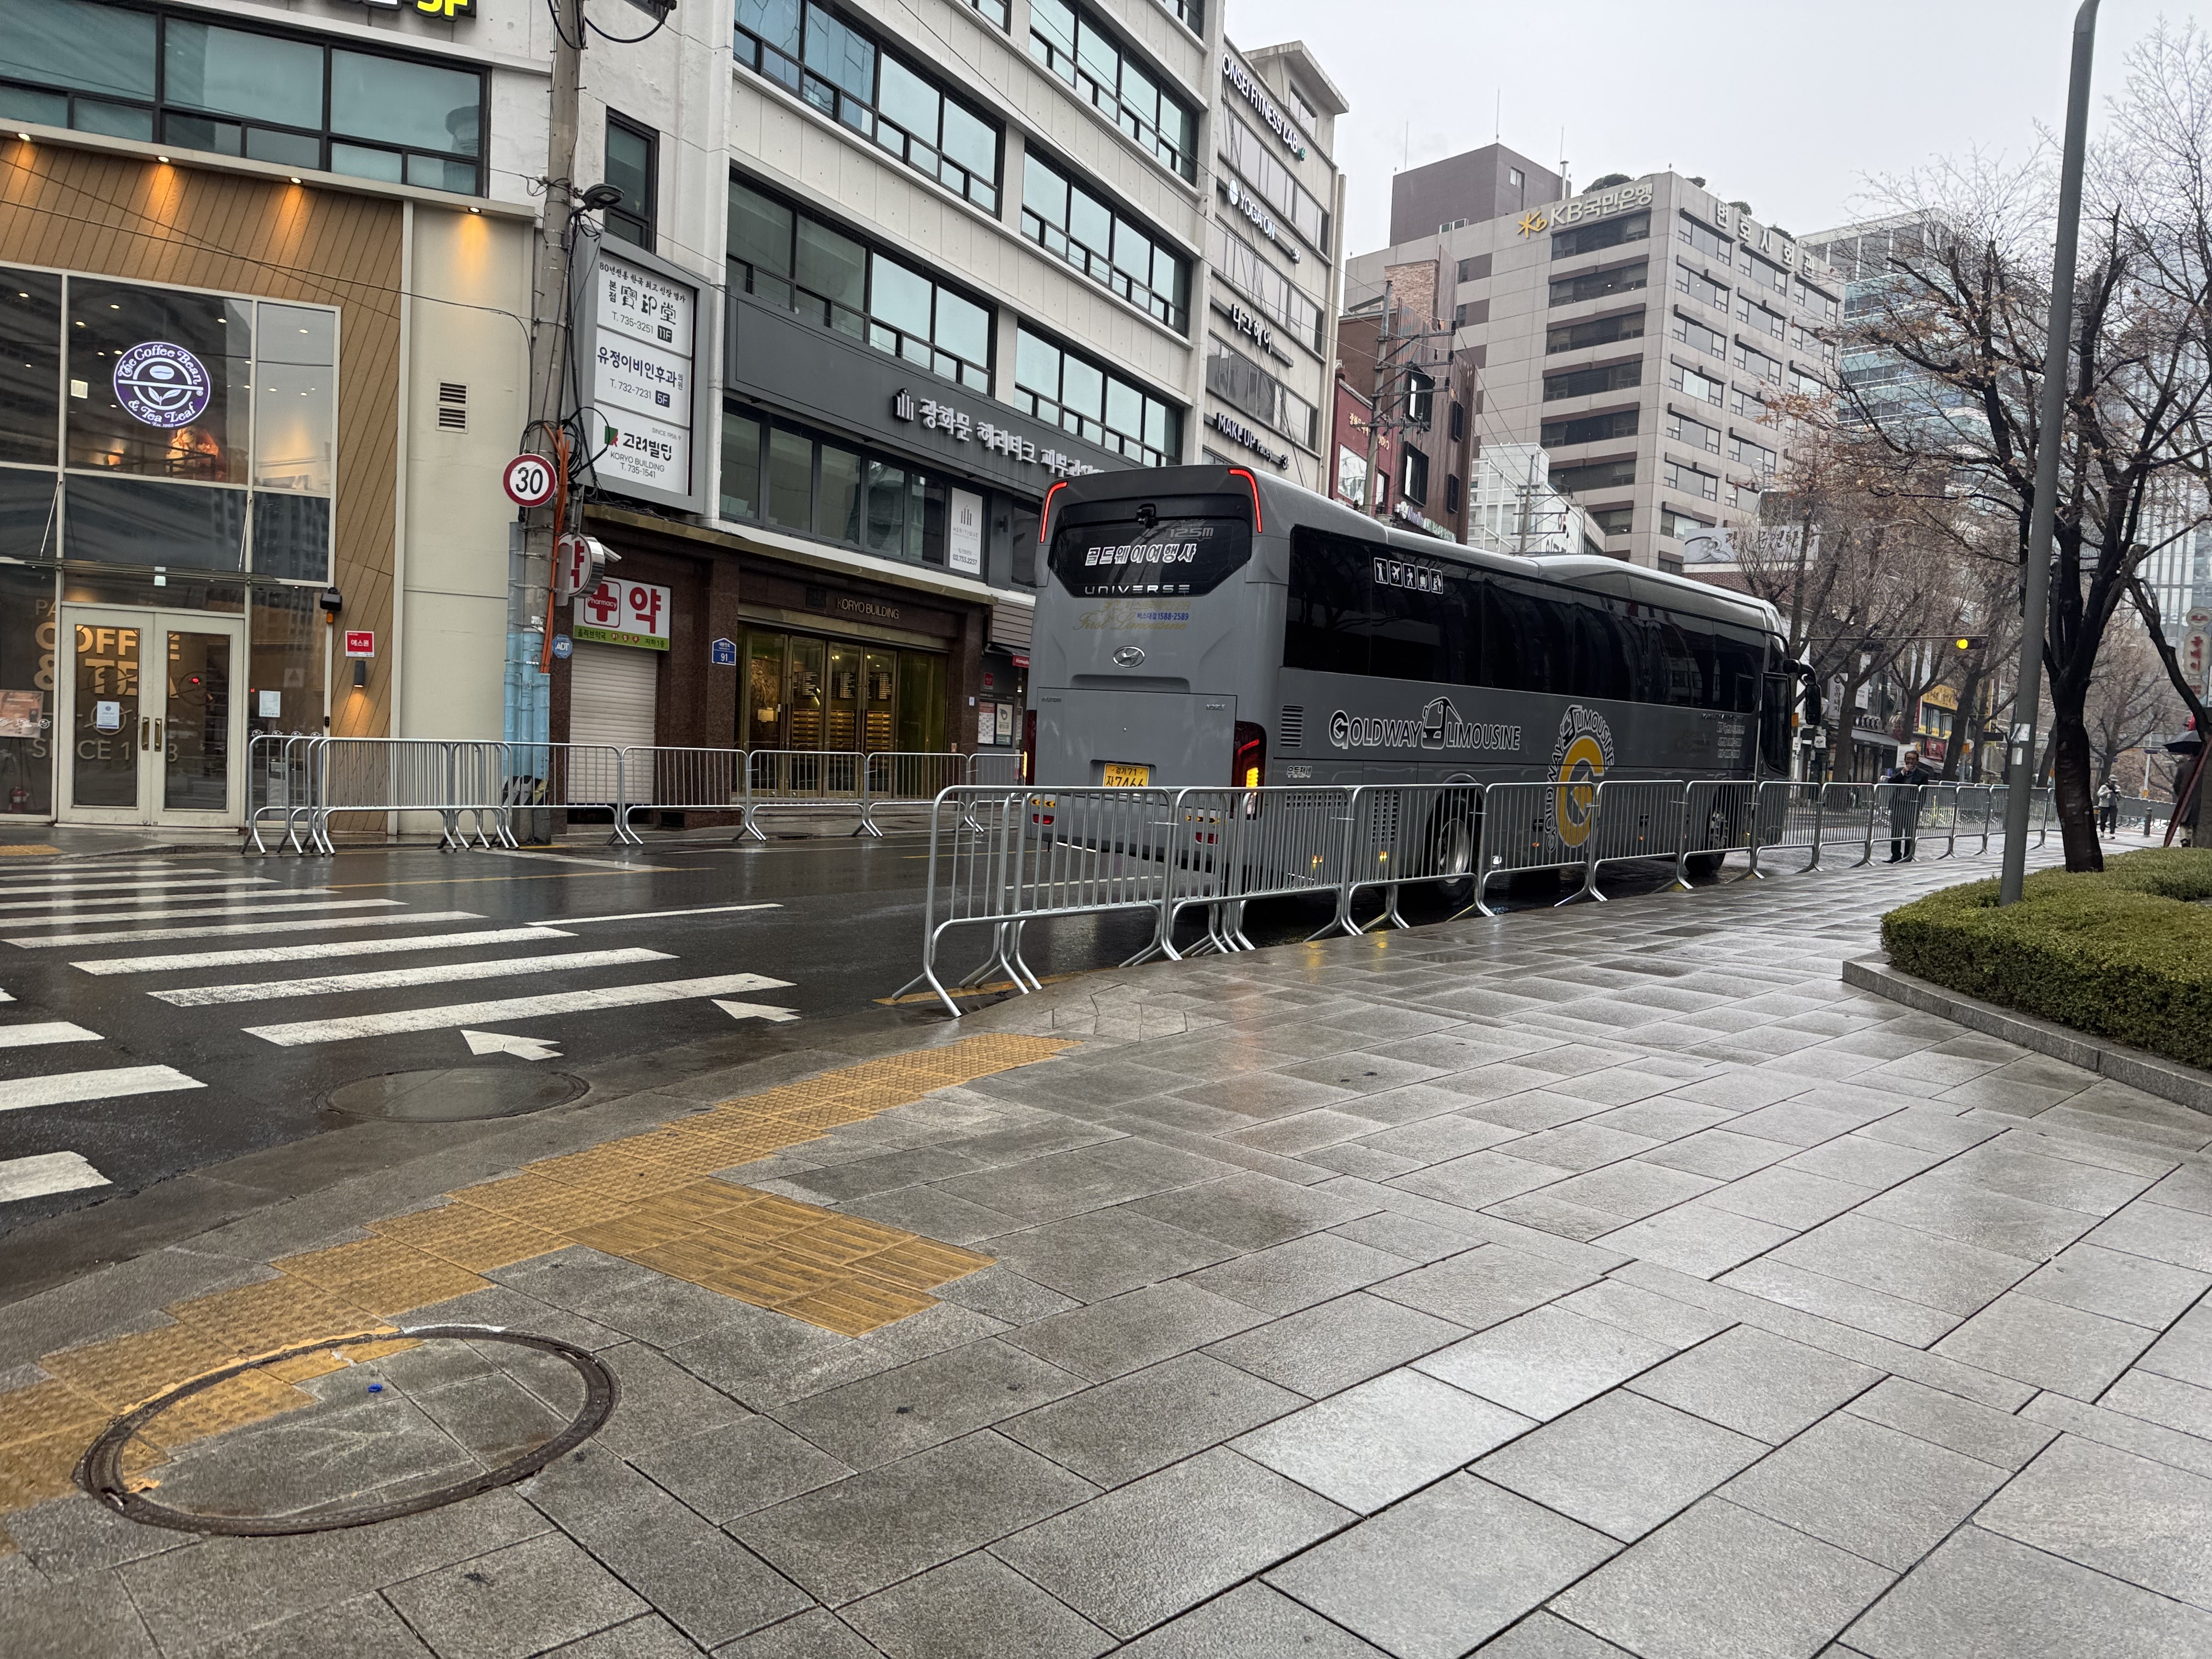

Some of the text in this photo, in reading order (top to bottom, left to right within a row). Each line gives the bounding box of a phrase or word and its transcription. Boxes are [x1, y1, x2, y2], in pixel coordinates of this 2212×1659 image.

[1222, 53, 1250, 98] ONSEI
[1250, 84, 1282, 135] FITNESS
[1283, 121, 1298, 154] LAB
[1240, 190, 1262, 228] YOGA
[1263, 216, 1276, 240] ON
[1550, 183, 1654, 228] KB국민은행
[1717, 202, 1815, 278] 변호사회관
[599, 262, 629, 280] 80년전통
[630, 274, 644, 287] 한국
[645, 280, 658, 292] 최고
[659, 286, 673, 298] 인장
[608, 280, 617, 303] 본점
[620, 314, 653, 334] 735-3251
[658, 326, 672, 340] 11F
[117, 345, 202, 385] The Coffee Bean
[597, 346, 677, 388] 유정이비인후과
[618, 381, 652, 400] 732-7231
[657, 393, 668, 405] 5F
[678, 373, 683, 391] 의원
[128, 400, 196, 422] & Tea Leaf
[652, 427, 667, 437] SINCE
[918, 398, 1105, 478] 광화문 헤리티크 피부과
[1217, 413, 1242, 443] MAKE
[1243, 428, 1256, 449] UP
[623, 432, 672, 461] 고려빌딩
[610, 451, 665, 472] KORYO BUILDING
[628, 464, 656, 479] 735-1541
[516, 467, 543, 494] 30
[953, 527, 979, 538] HERITIQUE
[1084, 543, 1197, 567] 골드웨이여행사
[588, 596, 617, 608] Pharmacy
[629, 586, 662, 634] 약
[837, 597, 900, 620] KORYO BUILDING
[1158, 612, 1189, 621] 1588-2589
[555, 642, 569, 651] ADT
[720, 653, 728, 662] 91
[1329, 709, 1521, 751] GOLDWAY LIMOUSINE
[1573, 708, 1615, 770] LIMOUSINE
[1128, 768, 1137, 776] 71
